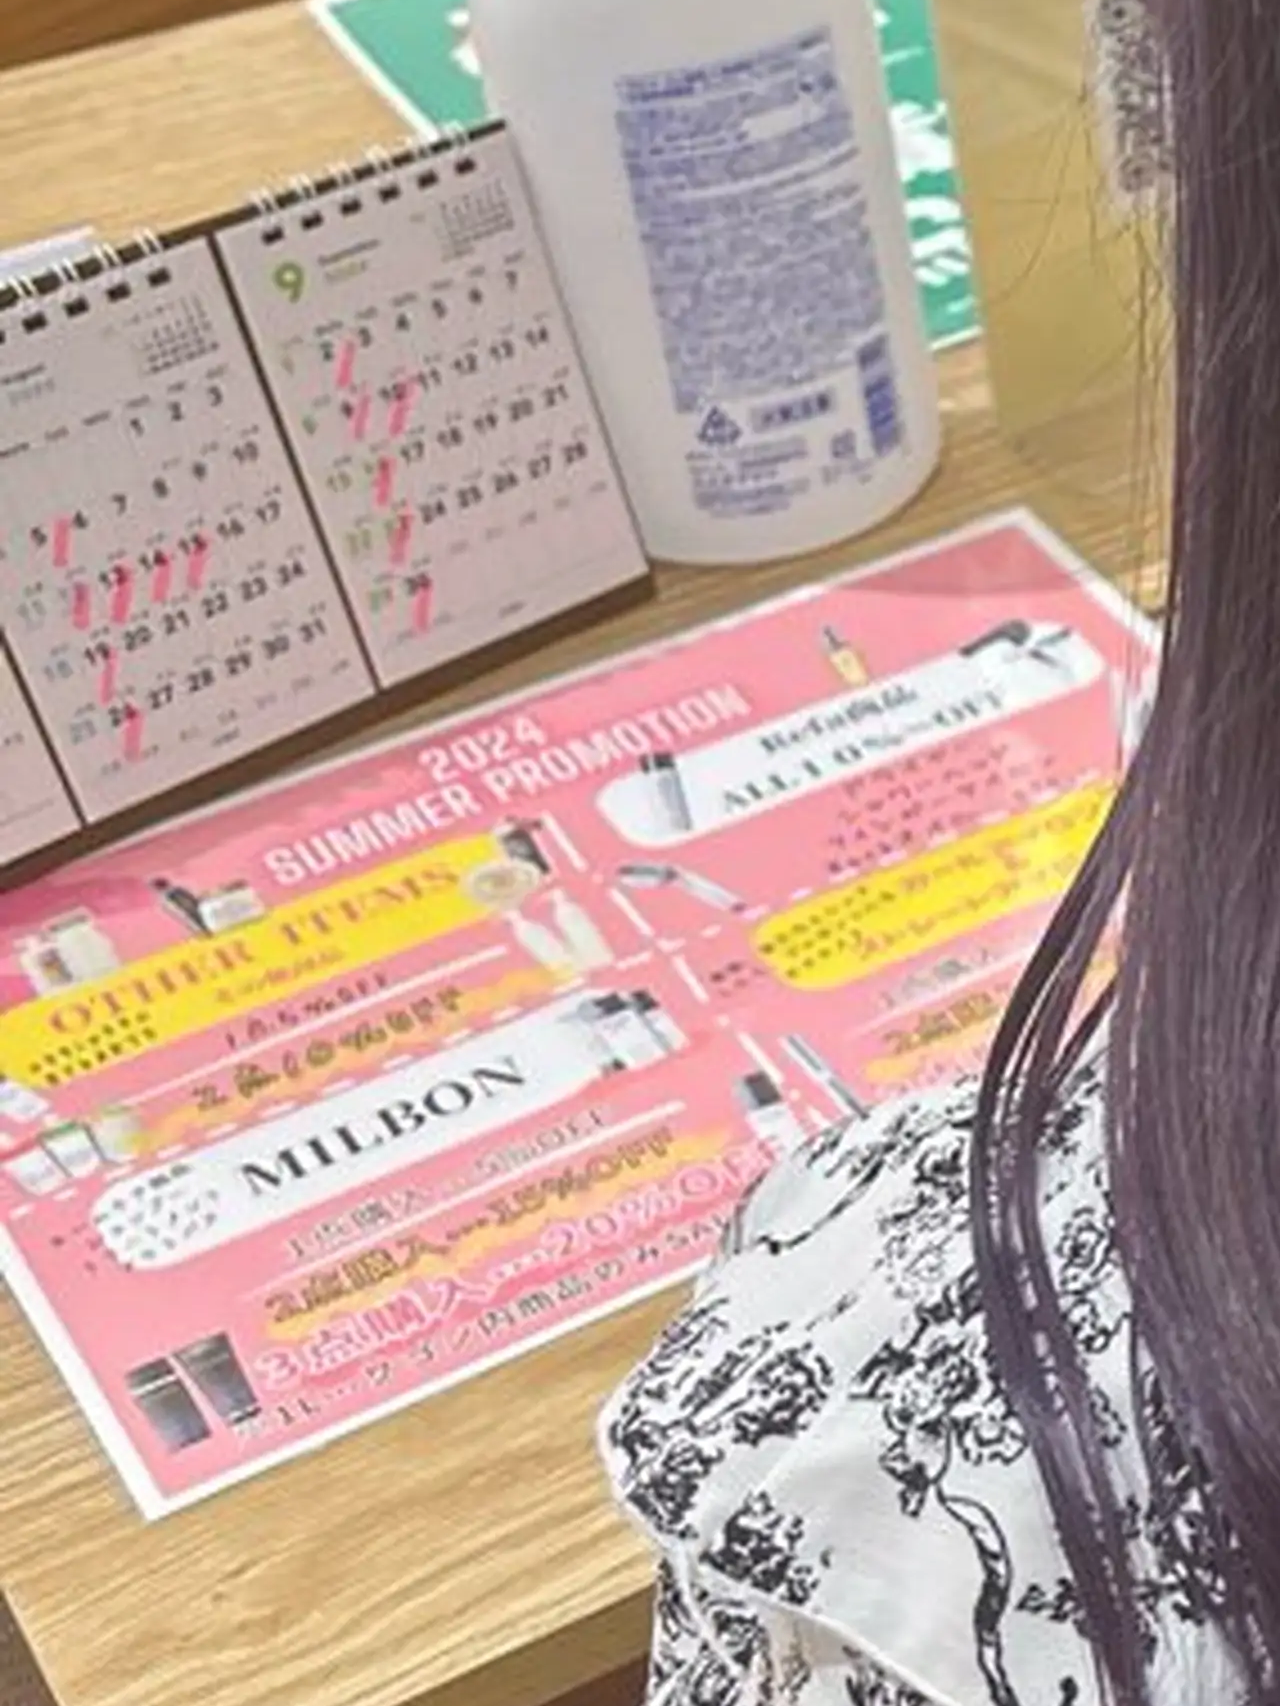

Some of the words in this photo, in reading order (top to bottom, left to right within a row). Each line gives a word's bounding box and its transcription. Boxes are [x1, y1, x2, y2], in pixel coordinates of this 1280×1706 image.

[273, 262, 304, 303] 9
[233, 440, 259, 464] 10
[401, 441, 425, 464] 17
[509, 398, 534, 422] 20
[542, 383, 569, 408] 21
[217, 518, 245, 541] 16
[255, 499, 282, 524] 17
[420, 501, 447, 525] 24
[457, 486, 483, 509] 25
[494, 471, 519, 494] 26
[528, 455, 552, 480] 27
[561, 441, 588, 465] 28
[123, 626, 152, 651] 20
[162, 610, 191, 635] 21
[202, 593, 230, 618] 22
[240, 576, 268, 601] 23
[277, 561, 306, 586] 24
[148, 683, 174, 710] 27
[187, 667, 215, 693] 28
[224, 651, 252, 676] 29
[262, 634, 290, 660] 30
[299, 618, 327, 643] 31
[263, 783, 482, 886] SUMMER
[483, 682, 753, 802] PROMOTION
[418, 714, 547, 783] 2024
[49, 938, 256, 1036] OTHER
[280, 861, 461, 946] ITEMS
[240, 1054, 526, 1198] MILBON
